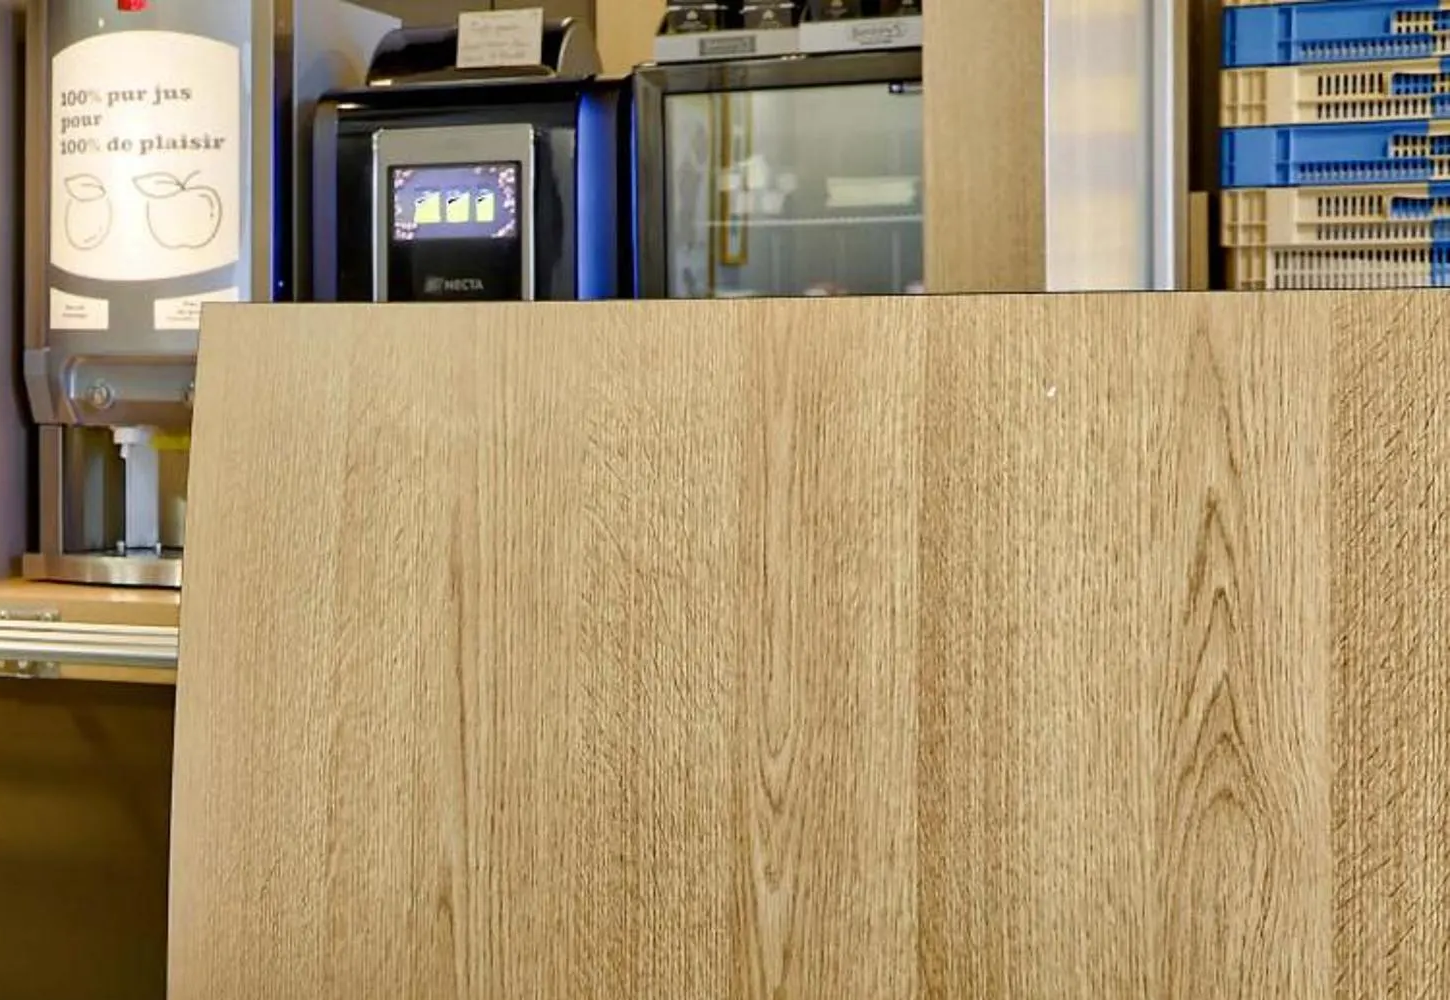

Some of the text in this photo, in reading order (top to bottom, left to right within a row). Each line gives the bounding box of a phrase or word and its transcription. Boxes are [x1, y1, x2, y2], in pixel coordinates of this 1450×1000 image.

[61, 84, 191, 107] 100% pur jus
[61, 113, 102, 134] pour
[61, 132, 225, 155] 100% de plaisir
